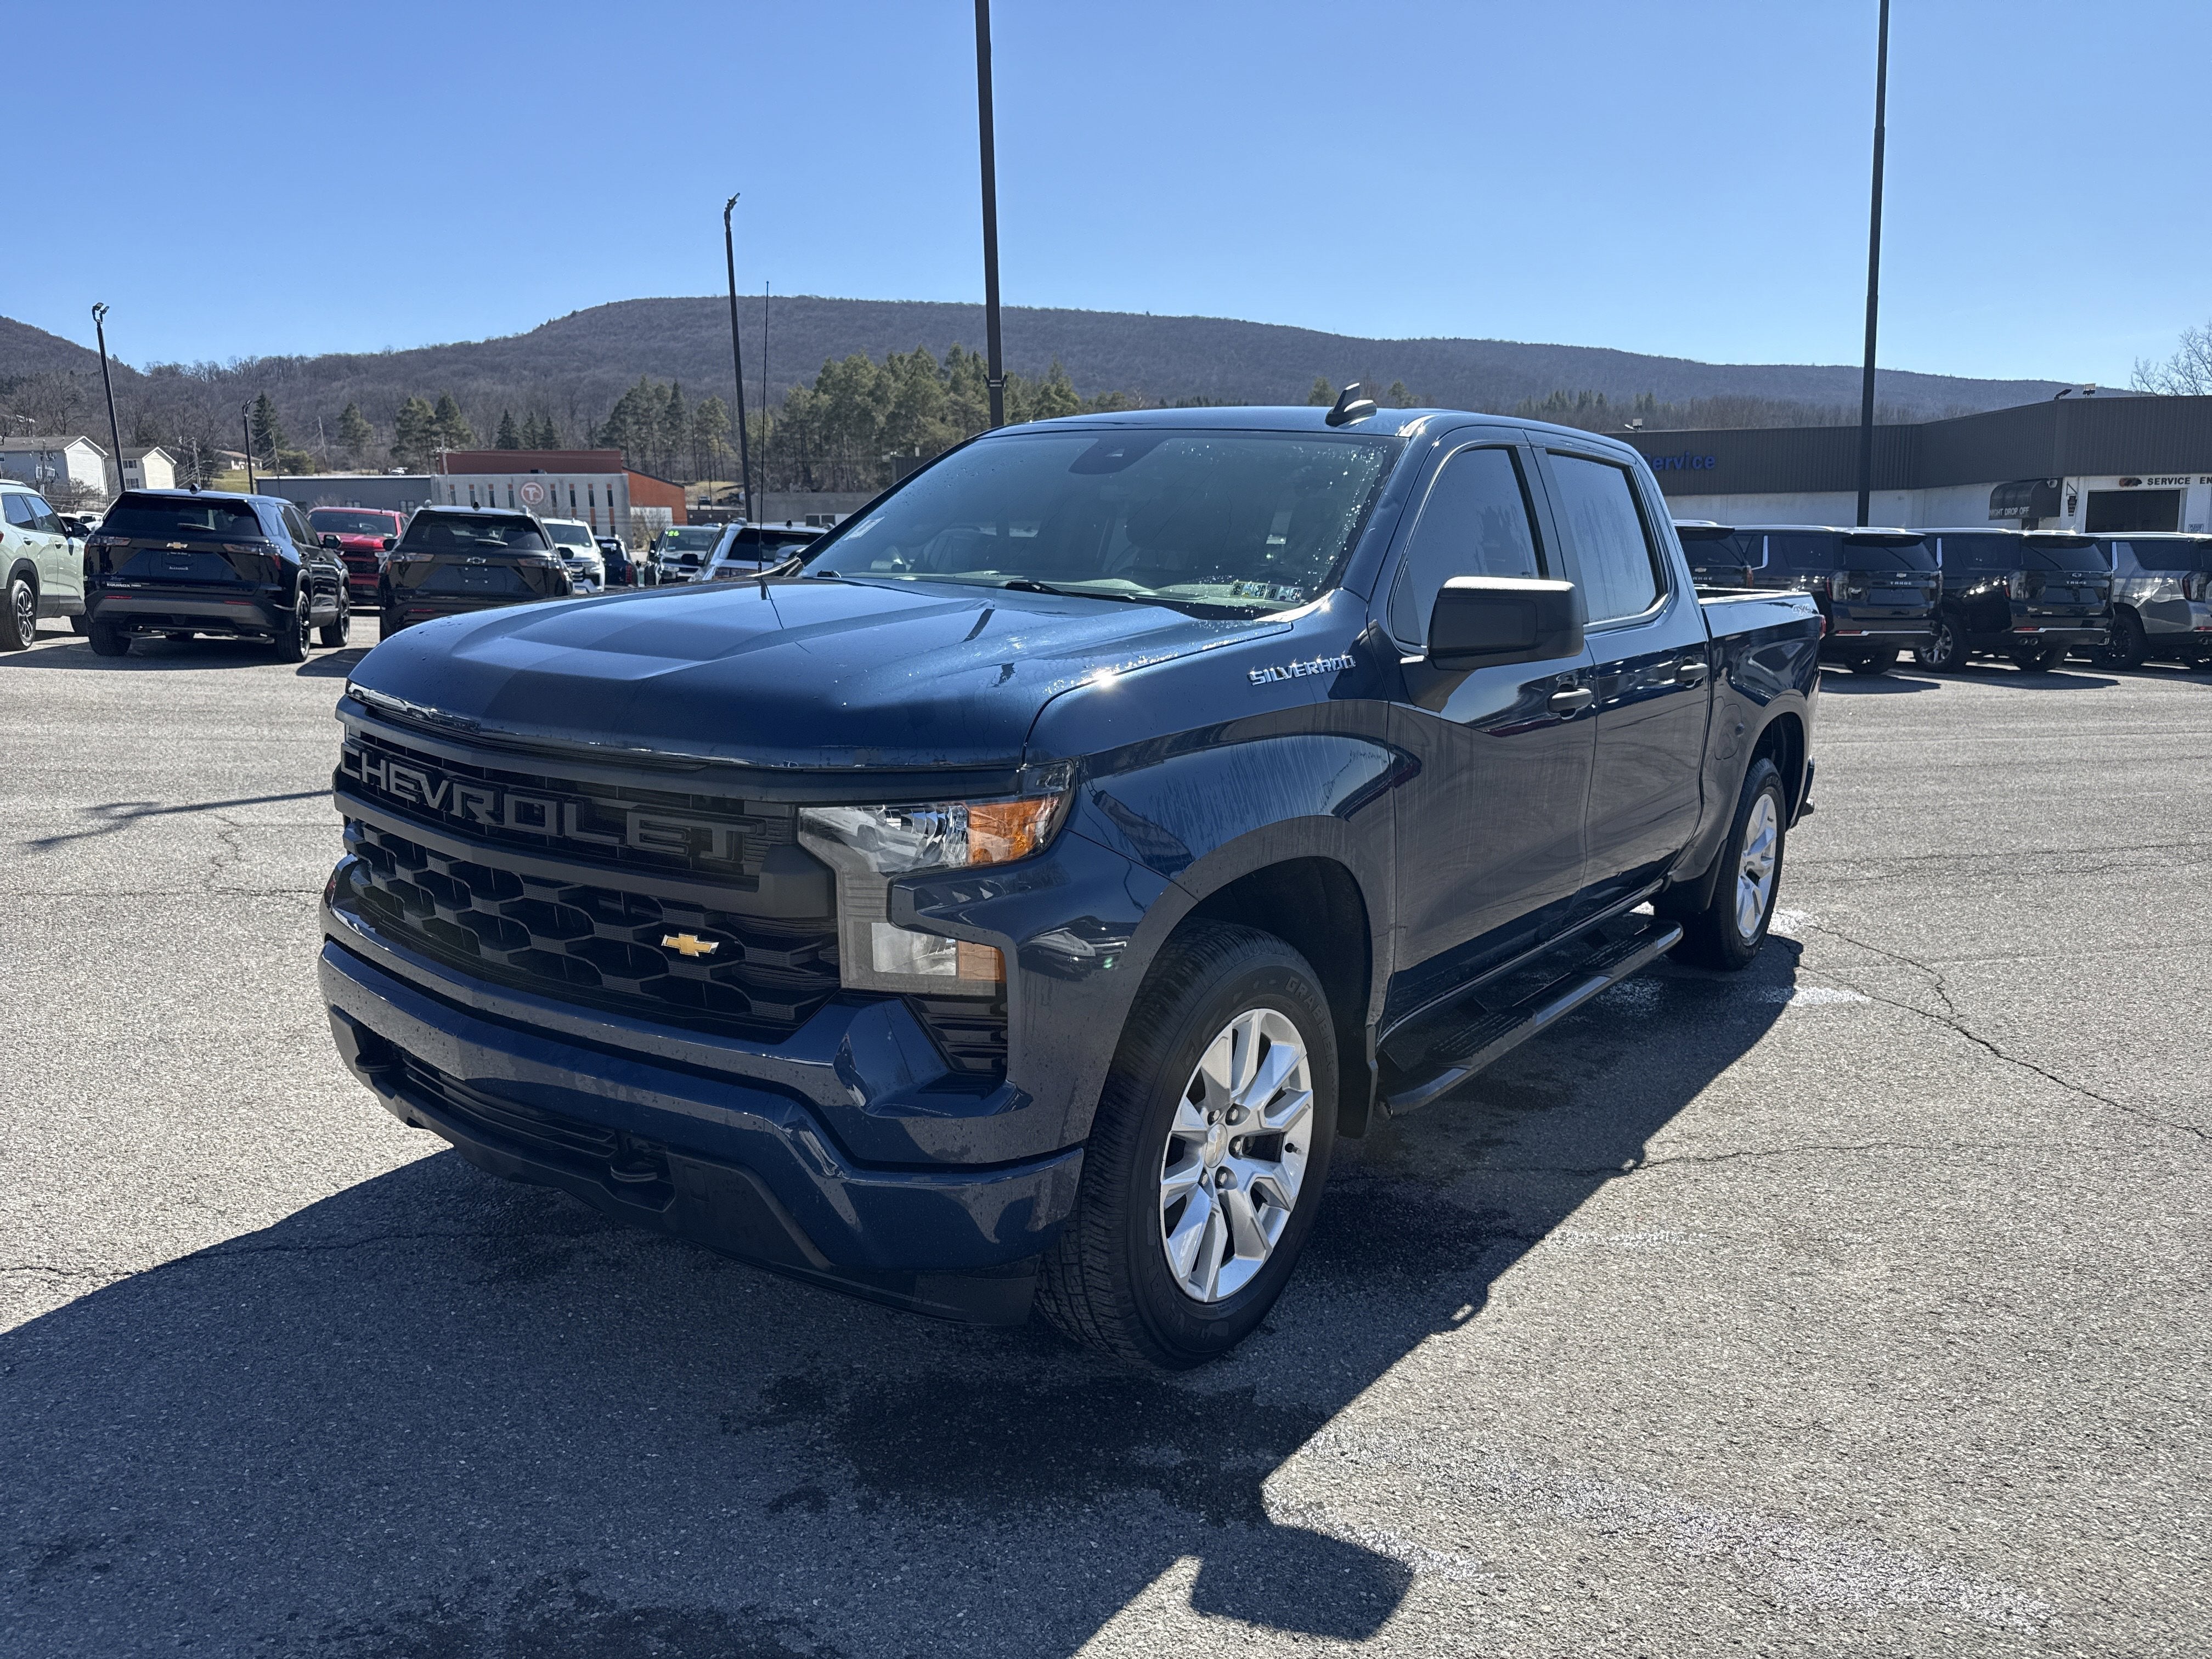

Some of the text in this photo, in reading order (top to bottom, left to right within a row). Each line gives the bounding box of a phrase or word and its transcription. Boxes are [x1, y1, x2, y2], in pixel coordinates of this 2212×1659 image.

[2147, 477, 2191, 486] SERVICE
[2005, 507, 2018, 516] DROP
[2019, 506, 2030, 515] OFF
[1247, 655, 1356, 686] SILVERADO
[341, 742, 768, 862] CHEVROLET
